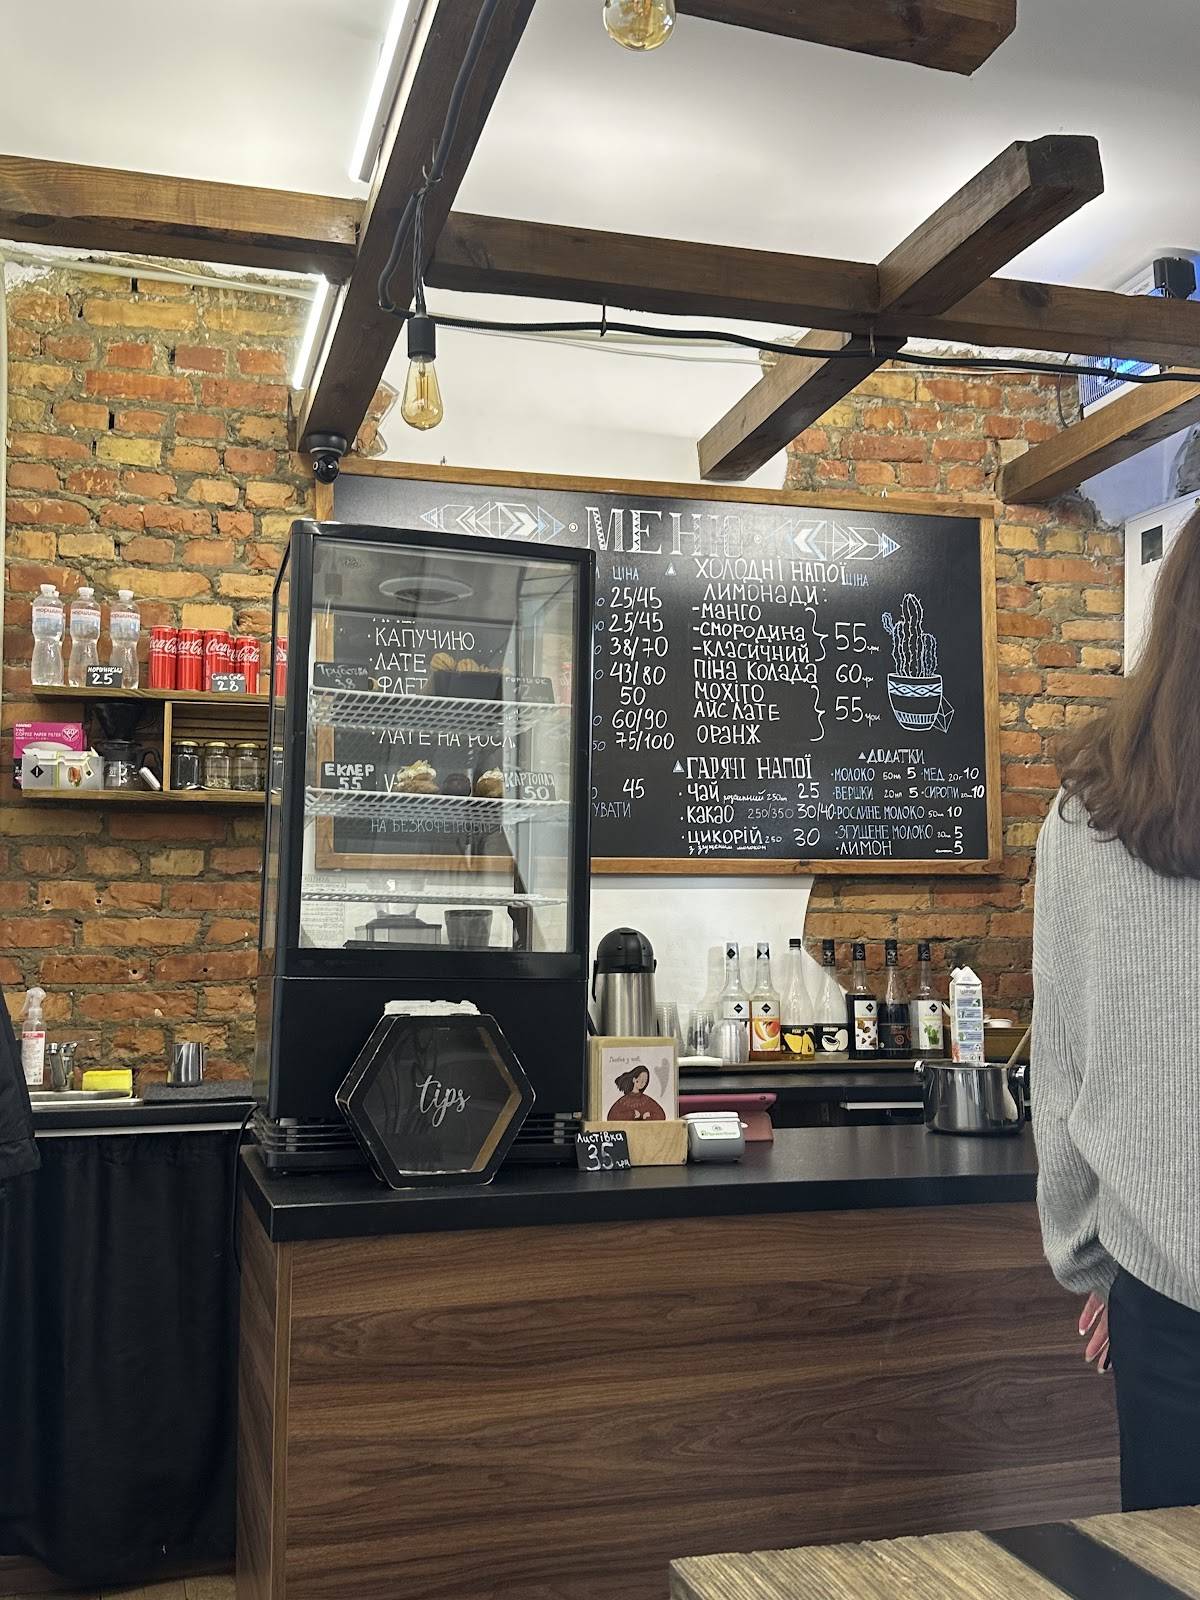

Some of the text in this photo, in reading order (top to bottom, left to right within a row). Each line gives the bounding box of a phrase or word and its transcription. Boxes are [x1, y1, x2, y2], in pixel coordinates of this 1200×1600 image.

[585, 507, 743, 558] МЕНЮ
[612, 566, 640, 581] ЦІНА
[695, 556, 847, 586] ХОЛОДНІ НАПОЇ
[610, 586, 662, 610] 25/45
[608, 611, 664, 636] 25/45
[375, 627, 475, 651] КАПУЧИНО
[835, 622, 867, 653] 55
[609, 636, 669, 661] 38/70
[374, 652, 427, 673] ЛАТЕ
[92, 672, 113, 685] 25
[609, 661, 666, 685] 43/80
[835, 664, 863, 683] 60
[217, 681, 239, 691] 28
[620, 686, 646, 705] 50
[835, 696, 864, 723] 55
[612, 708, 668, 732] 60/90
[615, 731, 675, 751] 75/100
[867, 749, 925, 765] ДОДАТКИ
[324, 763, 375, 777] ЕКЛЕР
[685, 754, 813, 780] ГАРЯЧІ НАПОЇ
[834, 767, 875, 782] МОЛОКО
[907, 766, 917, 779] 5
[923, 767, 945, 782] МЕД
[963, 767, 980, 780] 10
[339, 776, 364, 790] 55
[622, 778, 646, 799] 45
[797, 782, 820, 799] 25
[924, 785, 960, 800] СИРОПИ
[972, 785, 985, 799] 10
[522, 786, 550, 801] 50
[835, 785, 875, 801] ВЕРШКИ
[909, 786, 919, 798] 5
[747, 804, 794, 820] 250/350
[836, 806, 882, 820] РОСЛИНЕ
[883, 805, 925, 821] МОЛОКО
[946, 806, 963, 818] 10
[687, 826, 821, 847] ЦИКОРІЙ 250 30
[838, 825, 889, 840] ЗГУЩЕНЕ
[891, 824, 934, 840] МОЛОКО
[953, 826, 964, 839] 5
[840, 841, 893, 856] ЛИМОН
[953, 841, 964, 855] 5
[416, 1075, 471, 1128] tips
[586, 1142, 614, 1171] 35
